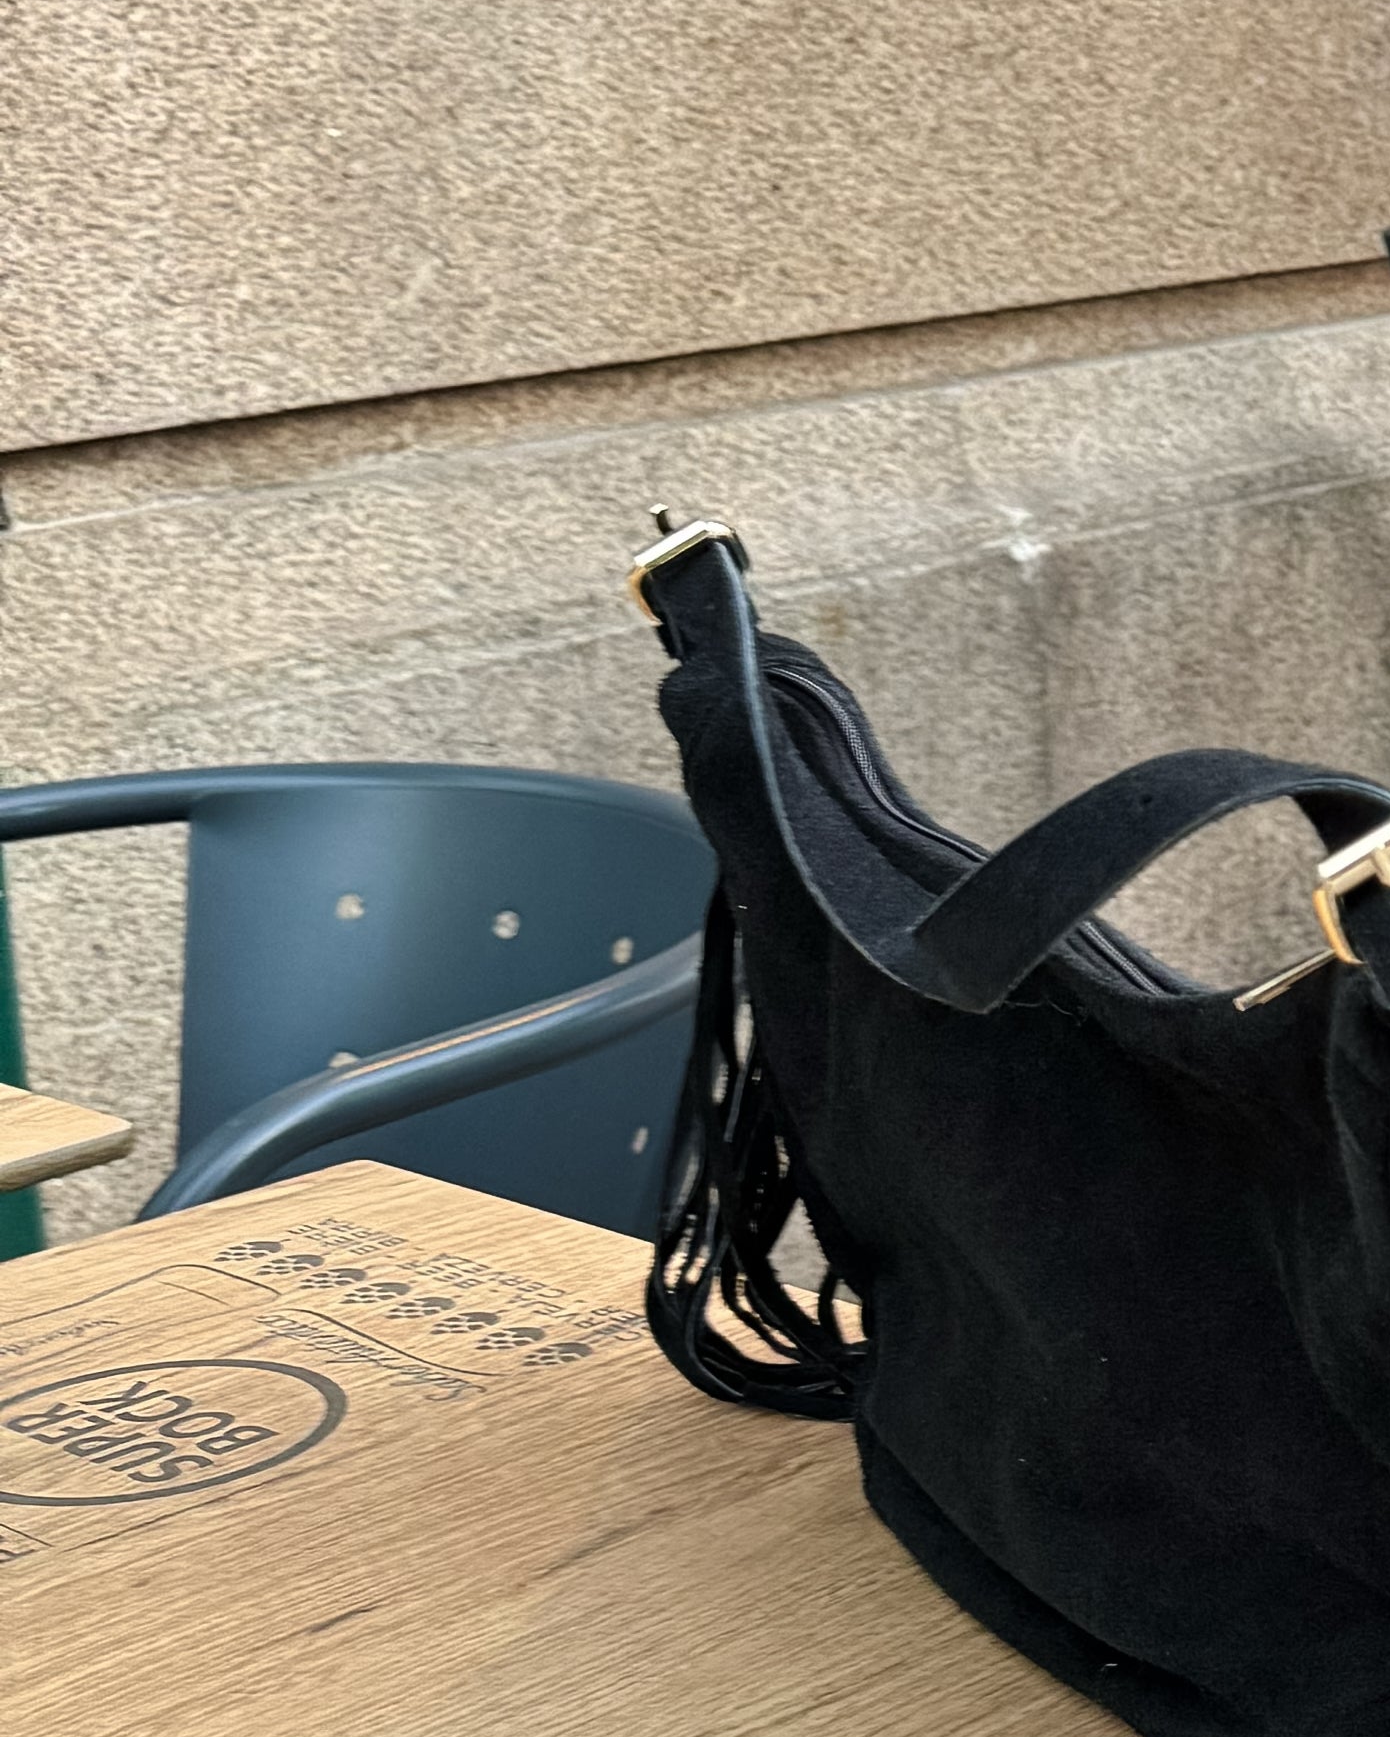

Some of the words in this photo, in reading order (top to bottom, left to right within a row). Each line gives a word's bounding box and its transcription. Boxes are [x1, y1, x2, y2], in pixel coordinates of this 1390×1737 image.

[397, 1260, 485, 1289] BEER
[427, 1252, 567, 1299] CERVEZA
[506, 1294, 642, 1341] CERVEJA
[77, 1380, 281, 1455] BOCK
[7, 1402, 214, 1483] SUPER
